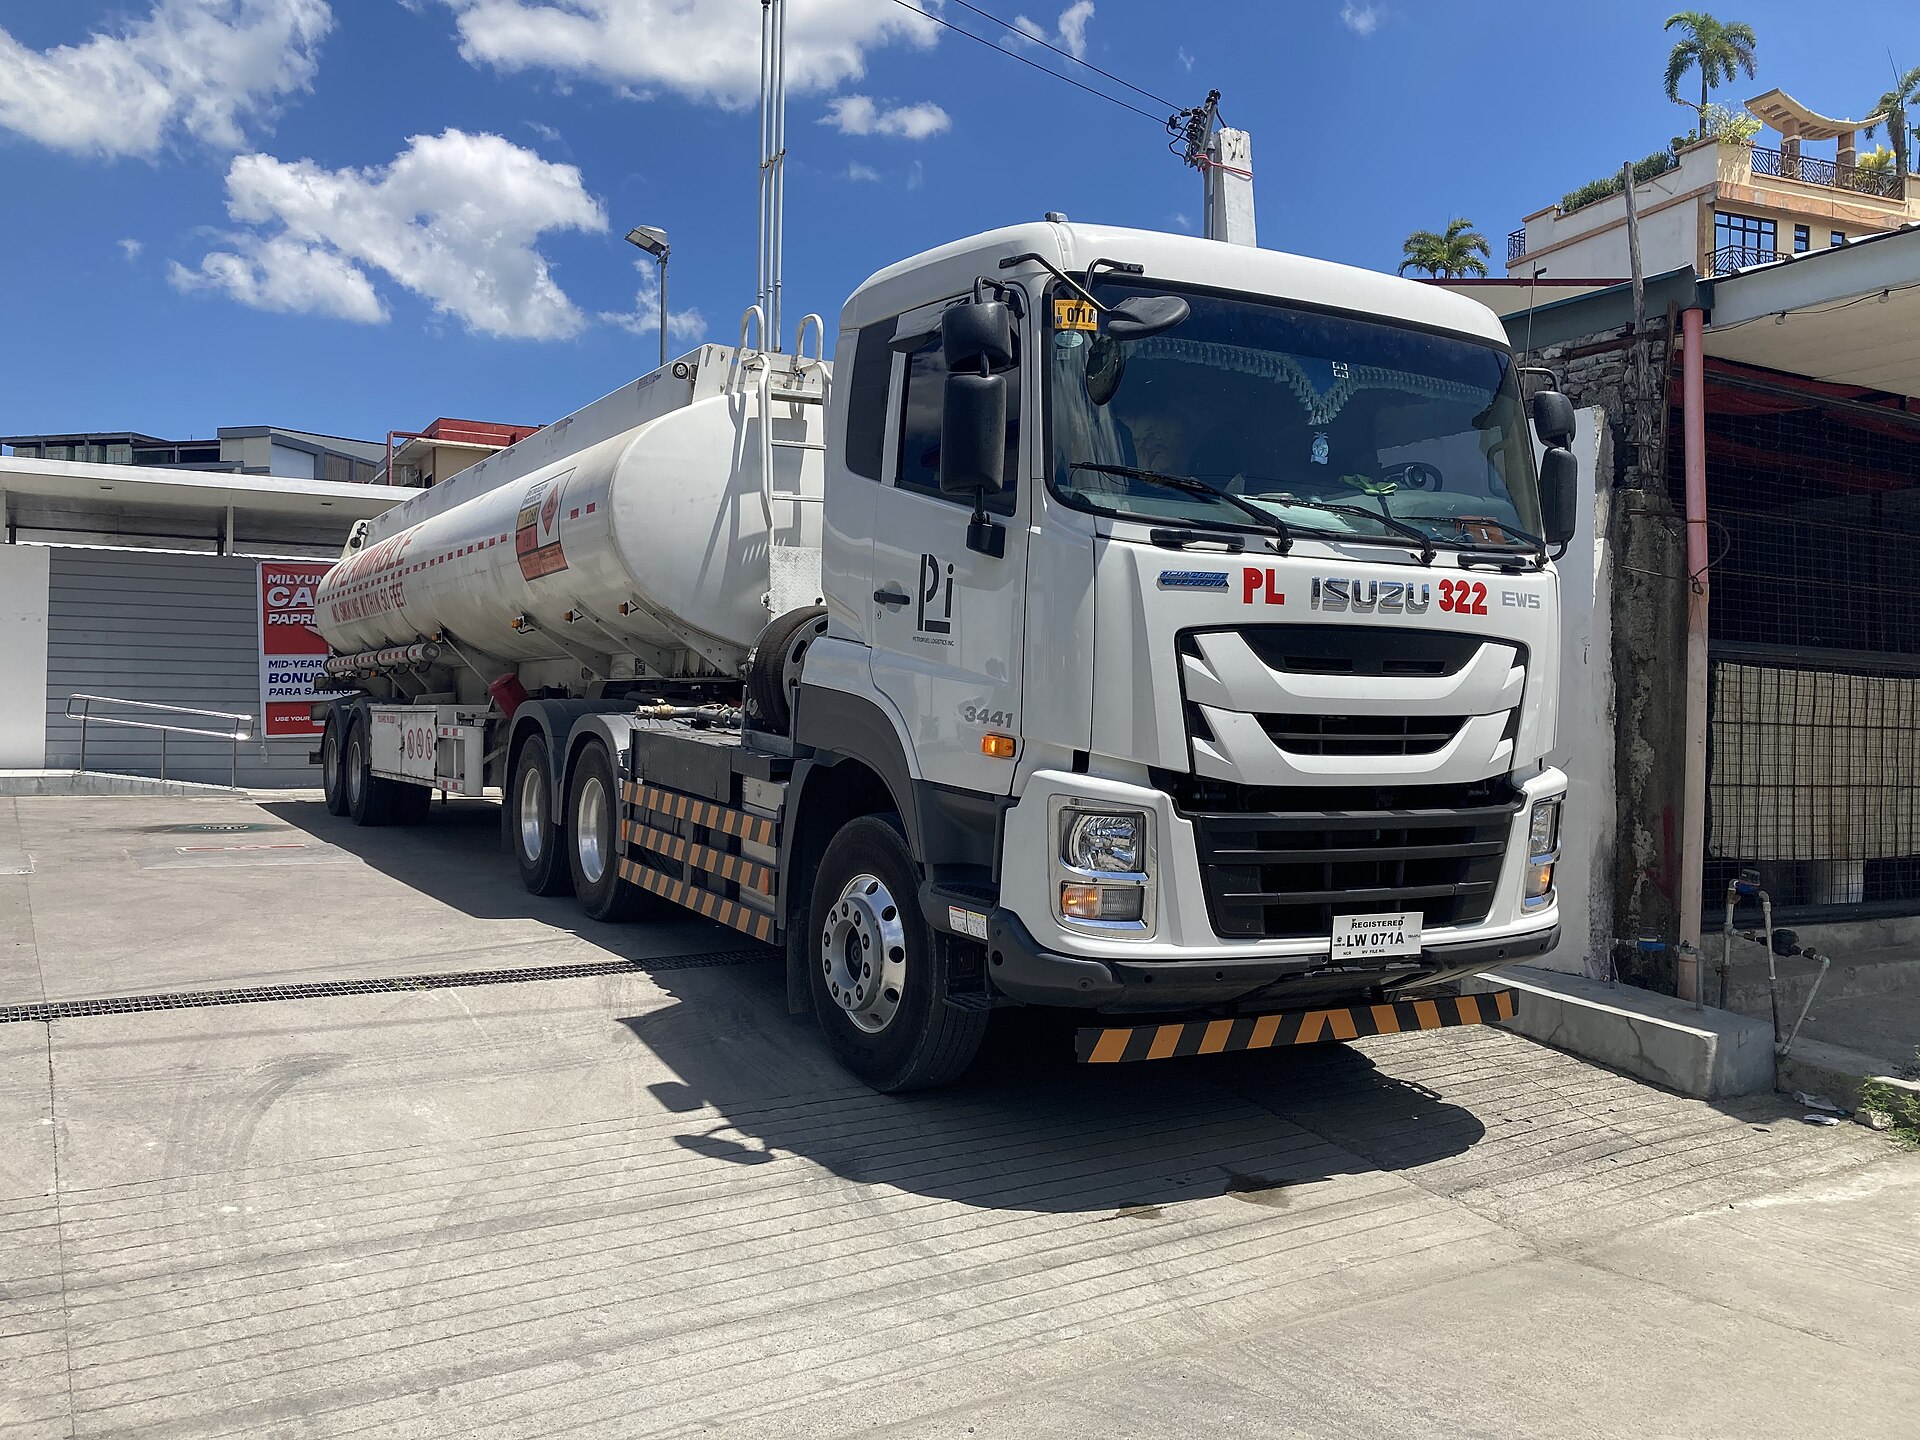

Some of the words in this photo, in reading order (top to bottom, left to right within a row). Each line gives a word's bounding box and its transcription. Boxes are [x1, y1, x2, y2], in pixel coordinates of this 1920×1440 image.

[389, 582, 407, 609] FEET
[1243, 567, 1285, 605] PL
[1311, 576, 1430, 613] ISUZU
[1438, 578, 1488, 615] 322
[268, 660, 322, 668] MID-YEAR
[269, 687, 301, 695] PARA
[964, 706, 1013, 728] 3441
[1352, 920, 1404, 928] REGISTERED
[1346, 933, 1367, 947] LW
[1370, 932, 1404, 945] 071A
